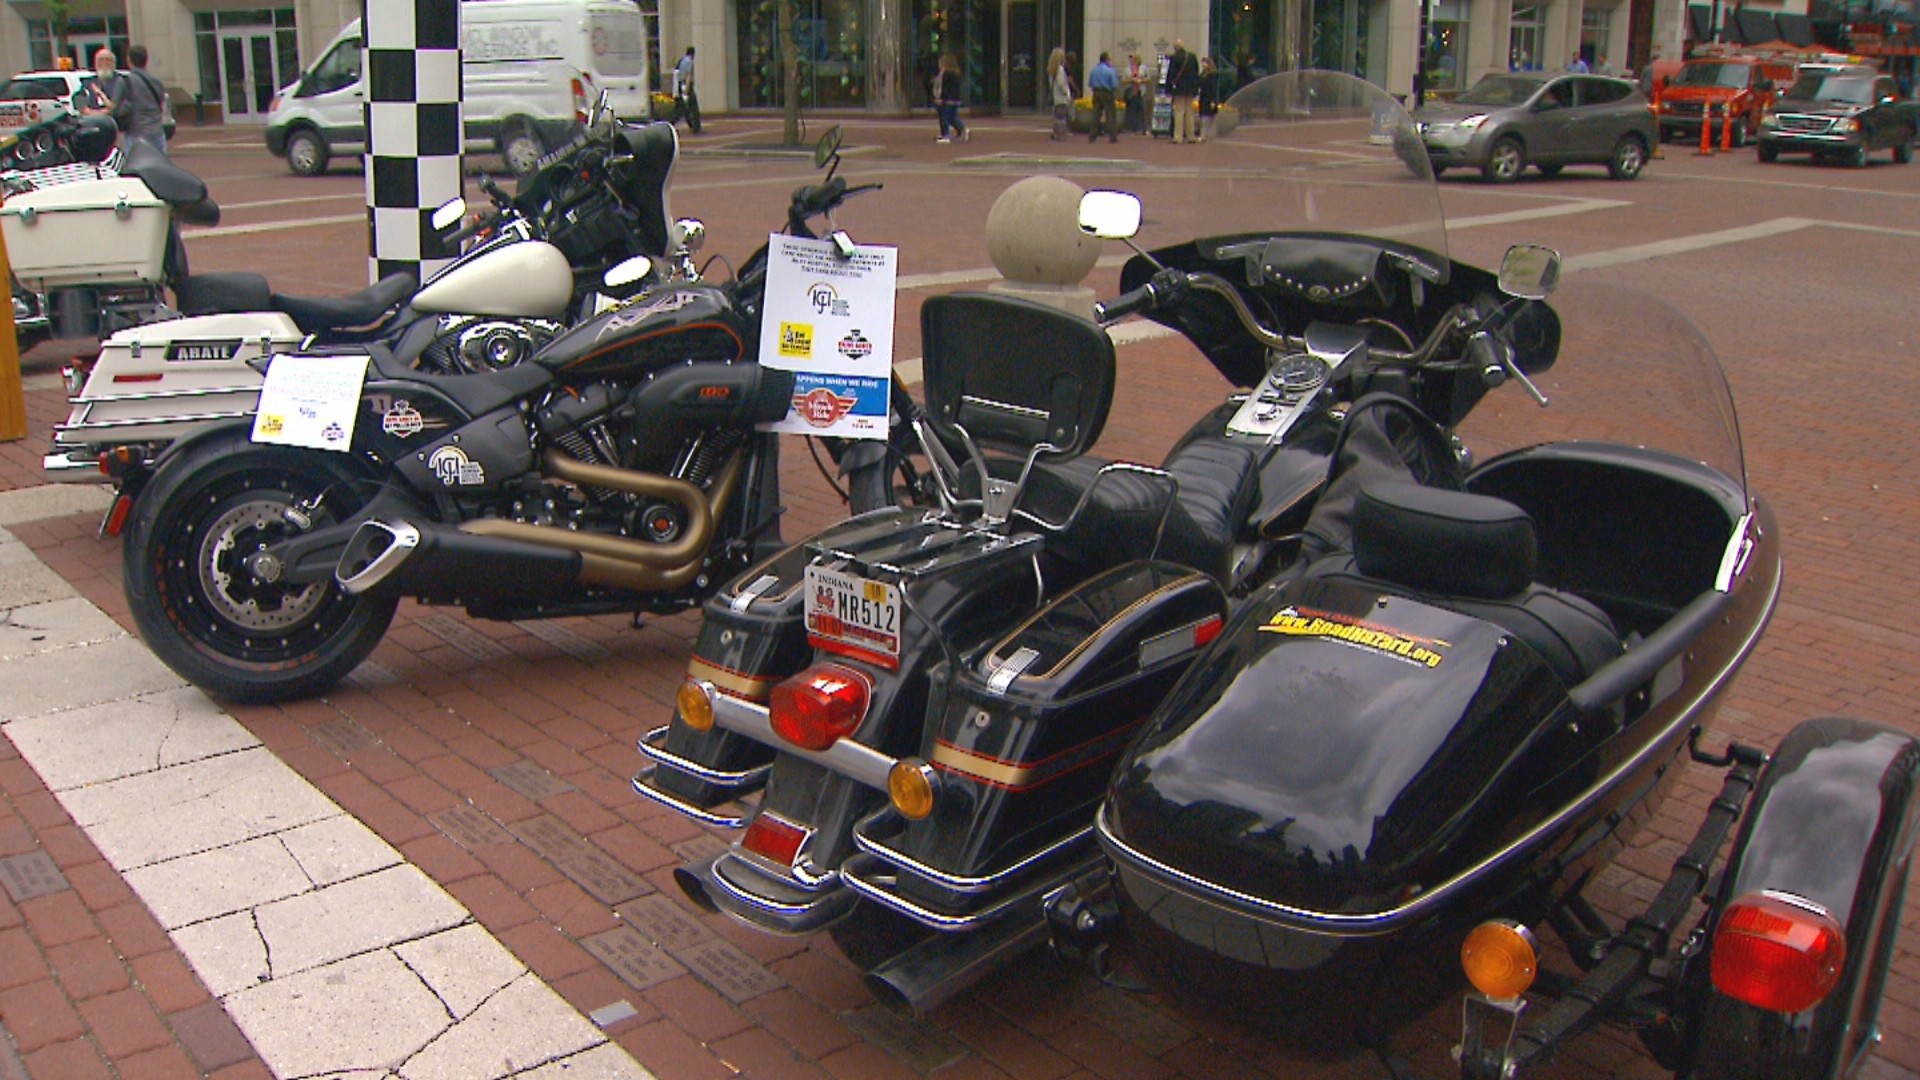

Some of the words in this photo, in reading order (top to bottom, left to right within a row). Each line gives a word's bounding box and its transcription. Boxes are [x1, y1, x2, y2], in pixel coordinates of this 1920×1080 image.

[177, 345, 230, 360] ABATE
[826, 377, 847, 387] WHEN
[848, 378, 861, 388] WE
[818, 573, 854, 591] INDIANA
